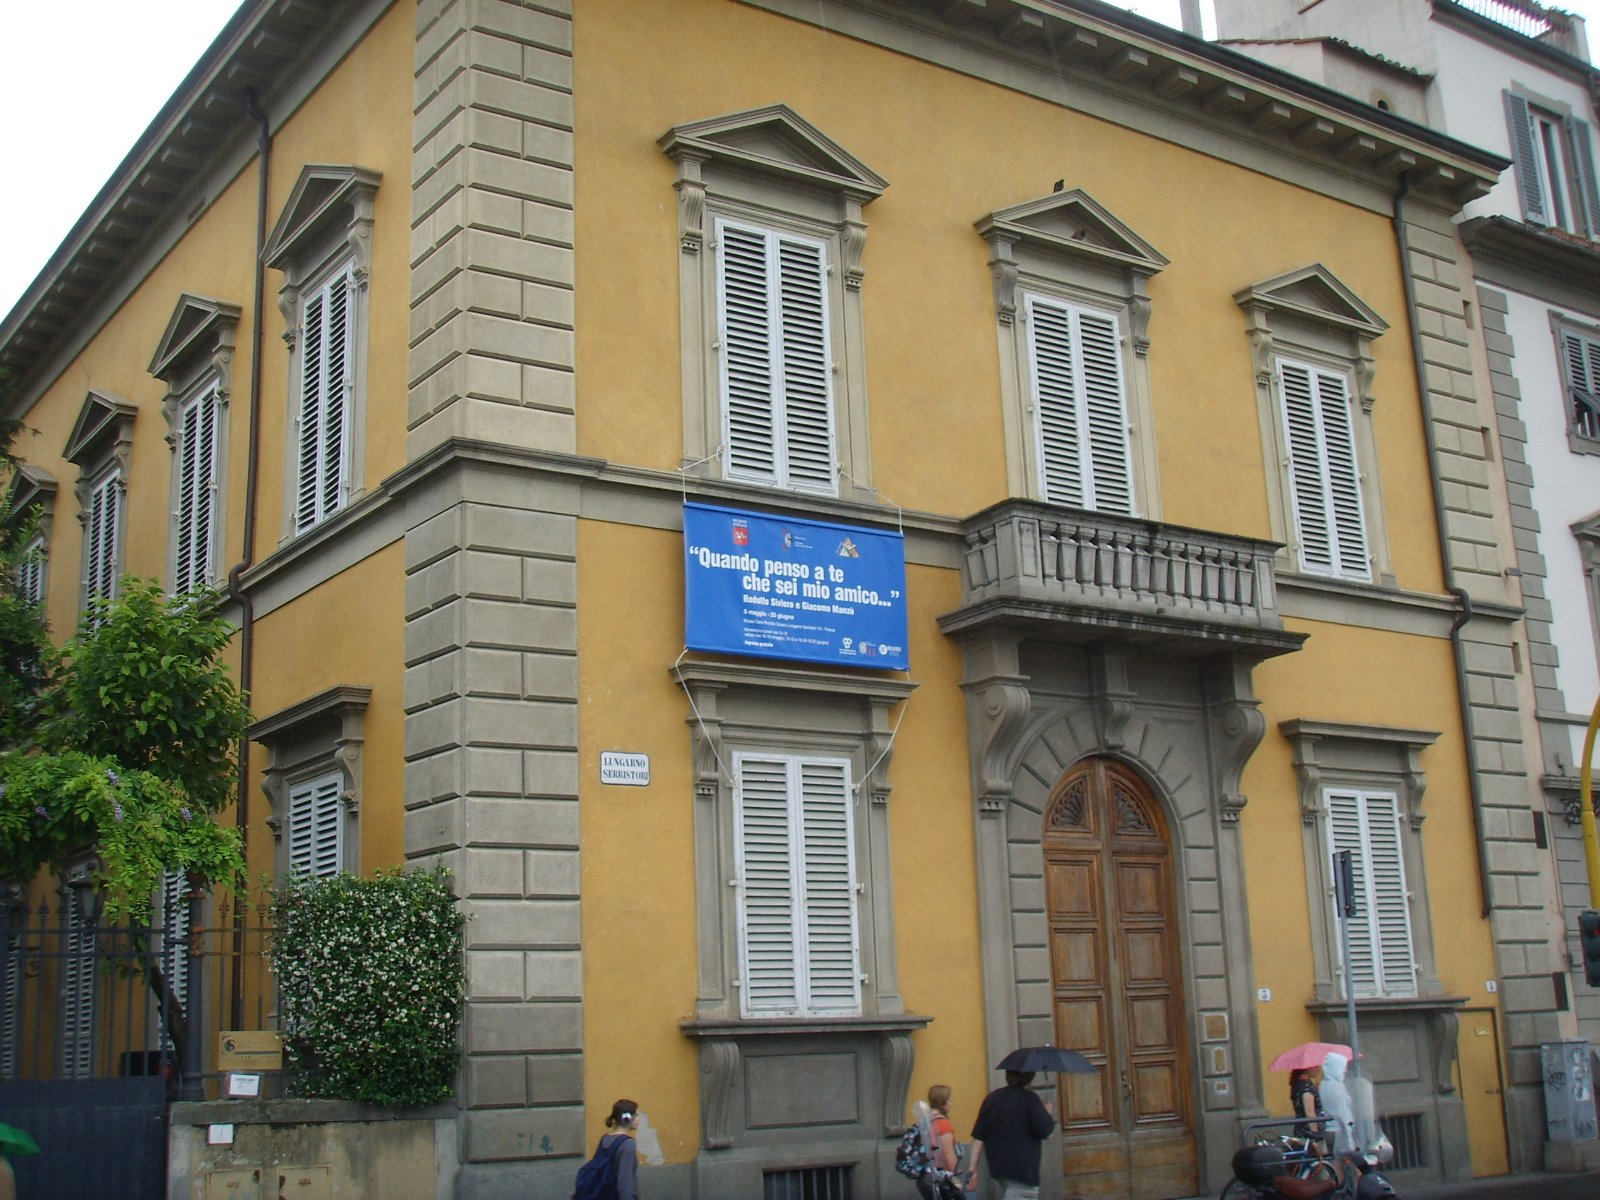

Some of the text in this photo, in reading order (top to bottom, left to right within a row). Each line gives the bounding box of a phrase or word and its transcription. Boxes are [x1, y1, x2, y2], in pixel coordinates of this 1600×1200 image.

[689, 545, 844, 583] “Quando penso a te
[742, 573, 900, 607] che sei mio amico...”
[743, 594, 769, 606] Rodolfo
[770, 598, 794, 609] Siviero
[802, 601, 831, 613] Giacomo
[604, 757, 646, 768] LUNGARNO
[603, 769, 648, 780] SERRISTORI
